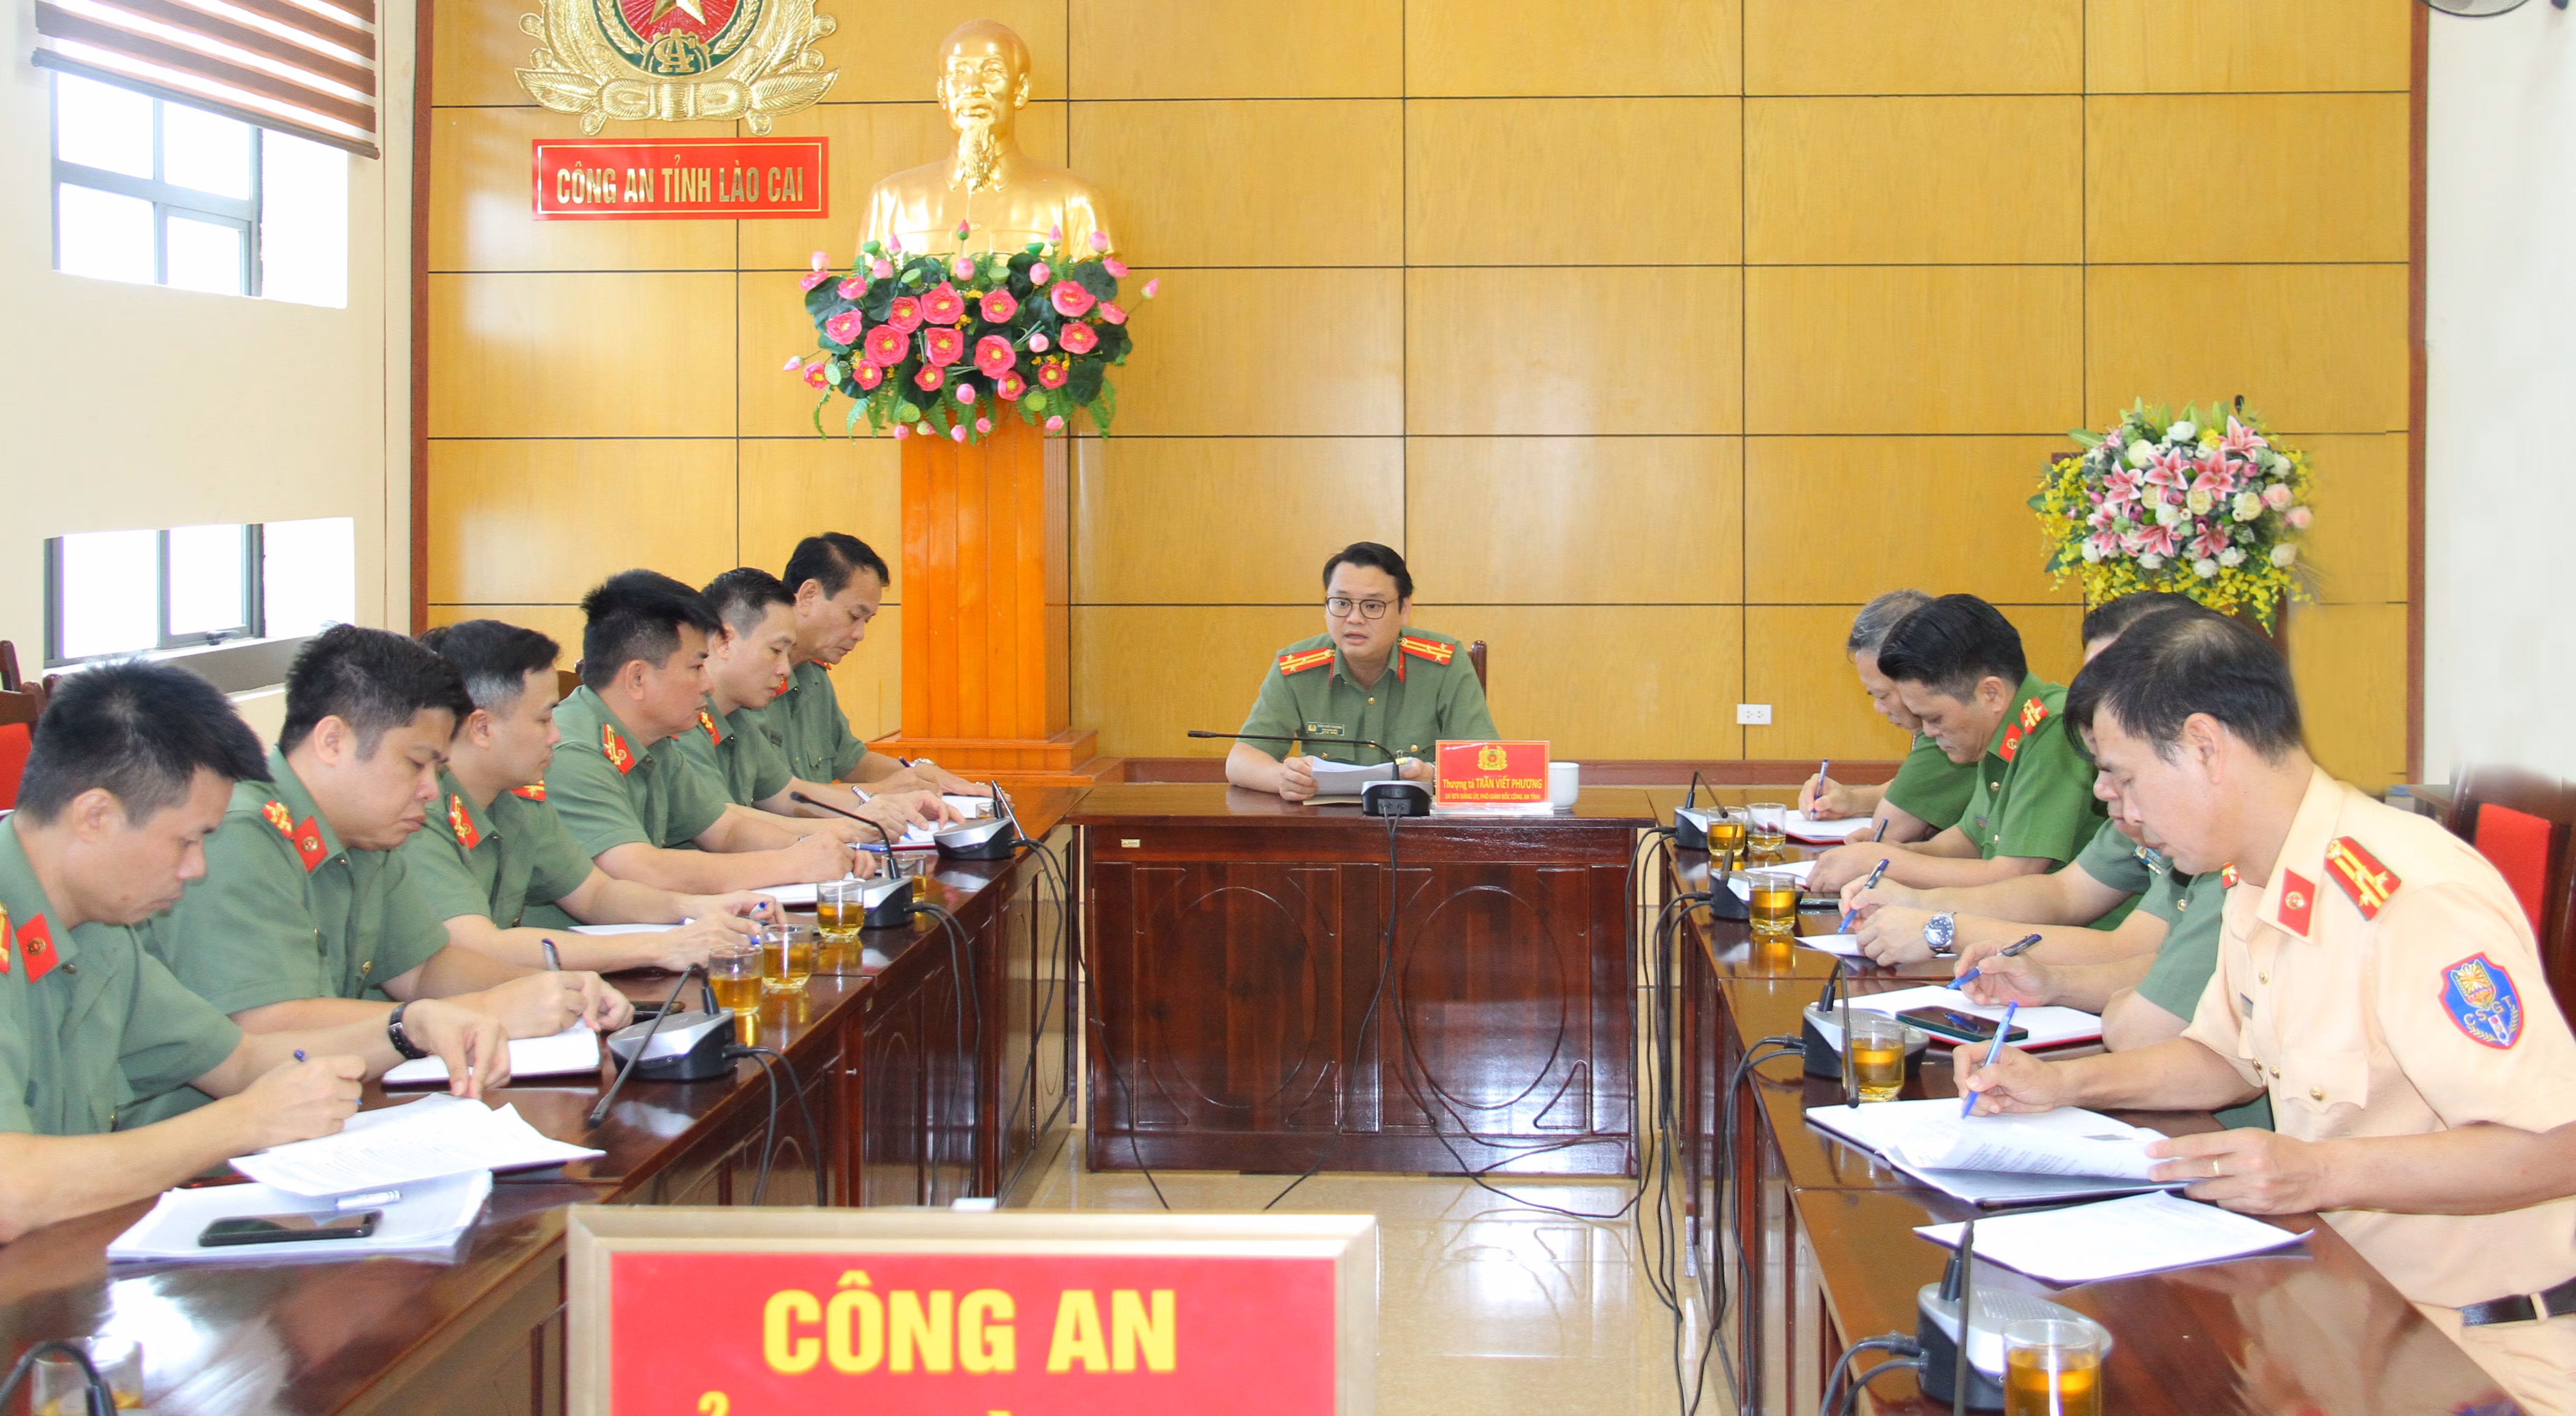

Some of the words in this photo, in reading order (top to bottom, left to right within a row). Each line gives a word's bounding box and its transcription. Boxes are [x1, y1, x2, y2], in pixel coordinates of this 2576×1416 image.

[557, 160, 617, 204] CÔNG
[624, 168, 654, 203] AN
[661, 154, 711, 203] TỈNH
[719, 159, 760, 203] LÀO
[767, 166, 803, 203] CAI
[1475, 774, 1494, 789] TRẦN
[1495, 774, 1511, 789] VIẾT
[1511, 778, 1543, 789] PHƯƠNG
[2464, 996, 2513, 1026] CSGT
[762, 1269, 1017, 1375] CÔNG
[1045, 1289, 1176, 1373] AN
